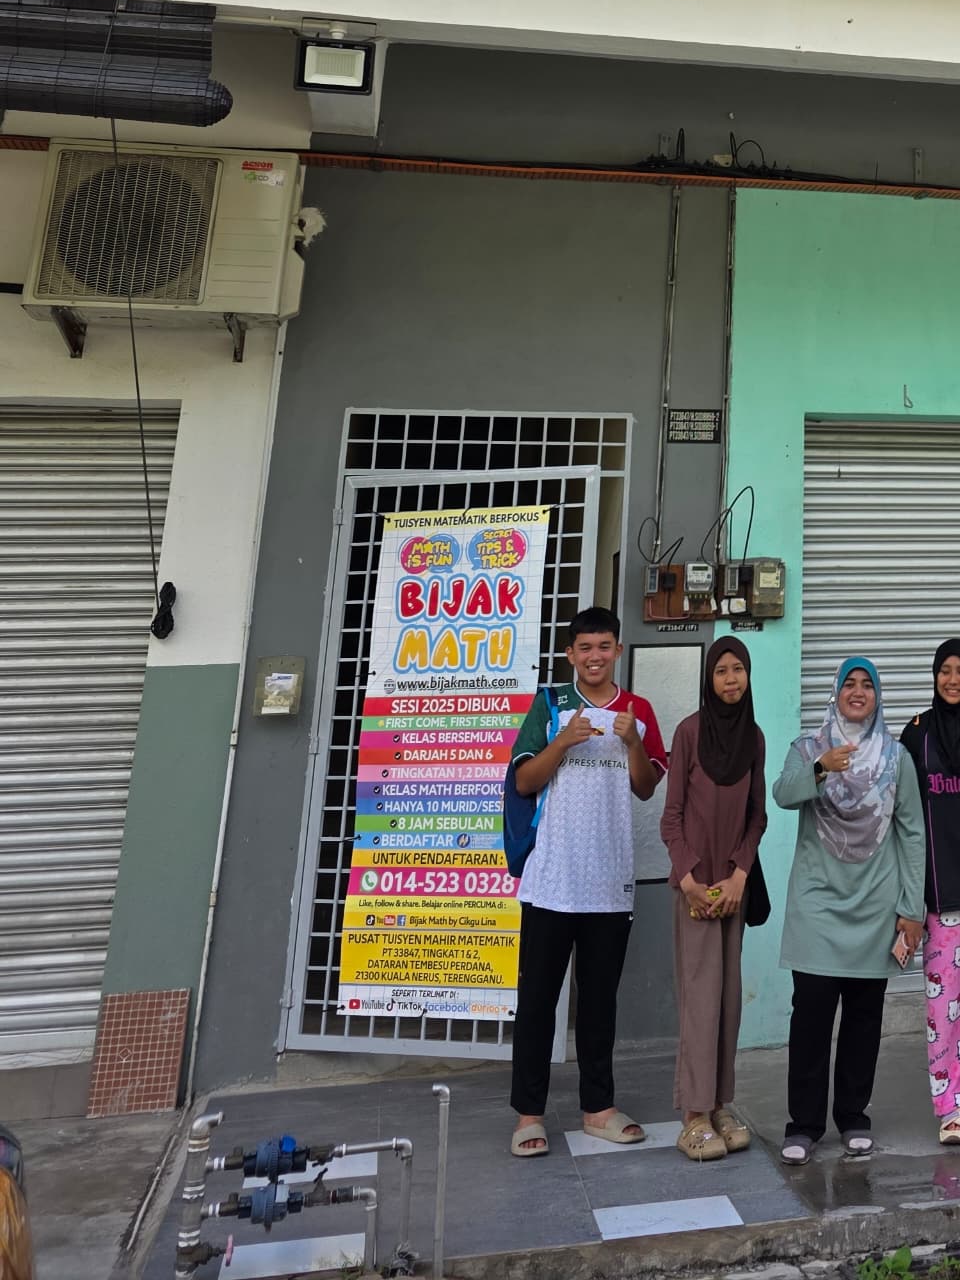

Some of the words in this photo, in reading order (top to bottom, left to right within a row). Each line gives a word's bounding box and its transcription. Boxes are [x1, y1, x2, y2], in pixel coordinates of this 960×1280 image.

[394, 517, 432, 528] TUISYEN
[433, 514, 489, 527] MATEMATIK
[489, 512, 539, 524] BERFOKUS
[426, 553, 453, 566] FUN
[398, 575, 524, 620] BIJAK
[395, 624, 516, 671] MATH
[396, 675, 519, 694] www.bijakmath.com
[391, 698, 420, 714] SESI
[421, 698, 455, 713] 2025
[457, 697, 511, 712] DIBUKA
[385, 718, 414, 729] FIRST
[415, 717, 448, 729] COME,
[450, 716, 479, 727] FIRST
[480, 716, 512, 727] SERVE
[402, 732, 436, 744] KELAS
[438, 731, 503, 743] BERSEMUKA
[403, 749, 448, 761] DARJAH
[450, 749, 457, 760] 5
[458, 749, 483, 760] DAN
[485, 749, 493, 760] 6
[568, 758, 596, 768] PRESS
[599, 759, 628, 770] METAL
[390, 767, 455, 779] TINGKATAN
[457, 767, 472, 780] 1,2
[474, 767, 499, 778] DAN
[382, 784, 417, 796] KELAS
[419, 784, 452, 796] MATH
[454, 783, 505, 796] BERFOKU
[384, 801, 424, 812] HANYA
[426, 801, 439, 812] 10
[398, 817, 406, 829] 8
[408, 817, 434, 830] JAM
[436, 817, 494, 830] SEBULAN
[381, 834, 453, 847] BERDAFTAR
[372, 852, 412, 865] UNTUK
[413, 852, 498, 865] PENDAFTARAN
[380, 871, 460, 893] 014-523
[464, 871, 515, 894] 0328
[375, 899, 394, 908] follow
[421, 900, 443, 910] Belajar
[443, 900, 463, 909] online
[464, 900, 497, 909] PERCUMA
[409, 915, 427, 927] Bijak
[428, 915, 448, 926] Math
[449, 916, 457, 928] by
[458, 916, 480, 928] Cikgu
[480, 916, 497, 926] Lina
[348, 933, 380, 944] PUSAT
[382, 933, 422, 945] TUISYEN
[423, 934, 456, 946] MAHIR
[457, 935, 515, 947] MATEMATIK
[382, 948, 393, 957] PT
[394, 948, 421, 958] 33847,
[422, 948, 461, 959] TINGKAT
[367, 959, 408, 969] DATARAN
[409, 960, 449, 971] TEMBESU
[450, 961, 494, 973] PERDANA,
[355, 971, 380, 981] 21300
[381, 971, 410, 982] KUALA
[411, 972, 441, 983] NERUS,
[443, 973, 505, 985] TERENGGANU.
[391, 989, 417, 997] SEPERTI
[419, 990, 449, 999] TERLIHAT
[361, 999, 385, 1010] YouTube
[397, 1001, 423, 1011] TikTok
[424, 1002, 469, 1013] facebook
